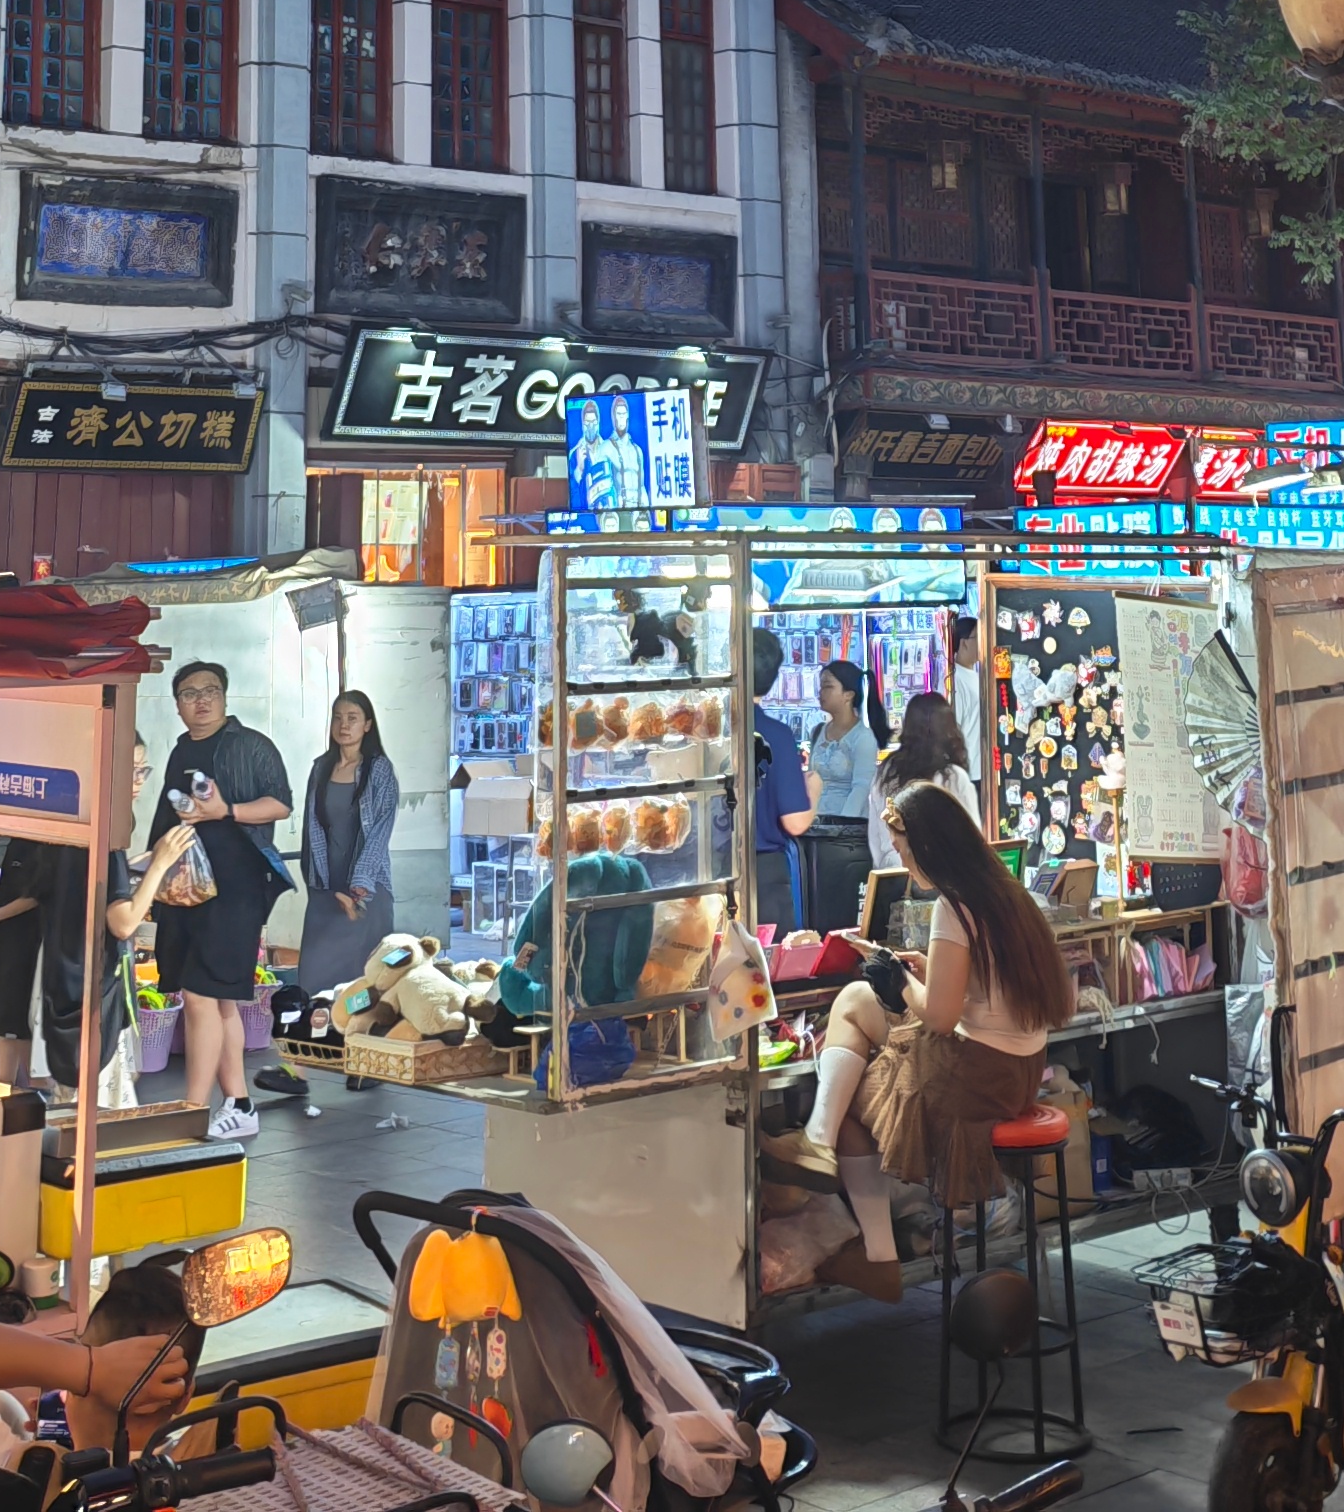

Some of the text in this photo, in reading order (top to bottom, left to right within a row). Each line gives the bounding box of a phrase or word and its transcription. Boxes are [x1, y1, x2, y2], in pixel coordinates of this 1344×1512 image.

[390, 350, 517, 425] 古茗
[31, 405, 60, 444] 古法
[66, 405, 236, 450] 濟公切糕
[652, 396, 689, 443] 手机
[654, 452, 692, 499] 贴膜
[1220, 508, 1257, 526] 充电宝
[1267, 509, 1302, 527] 自拍杆
